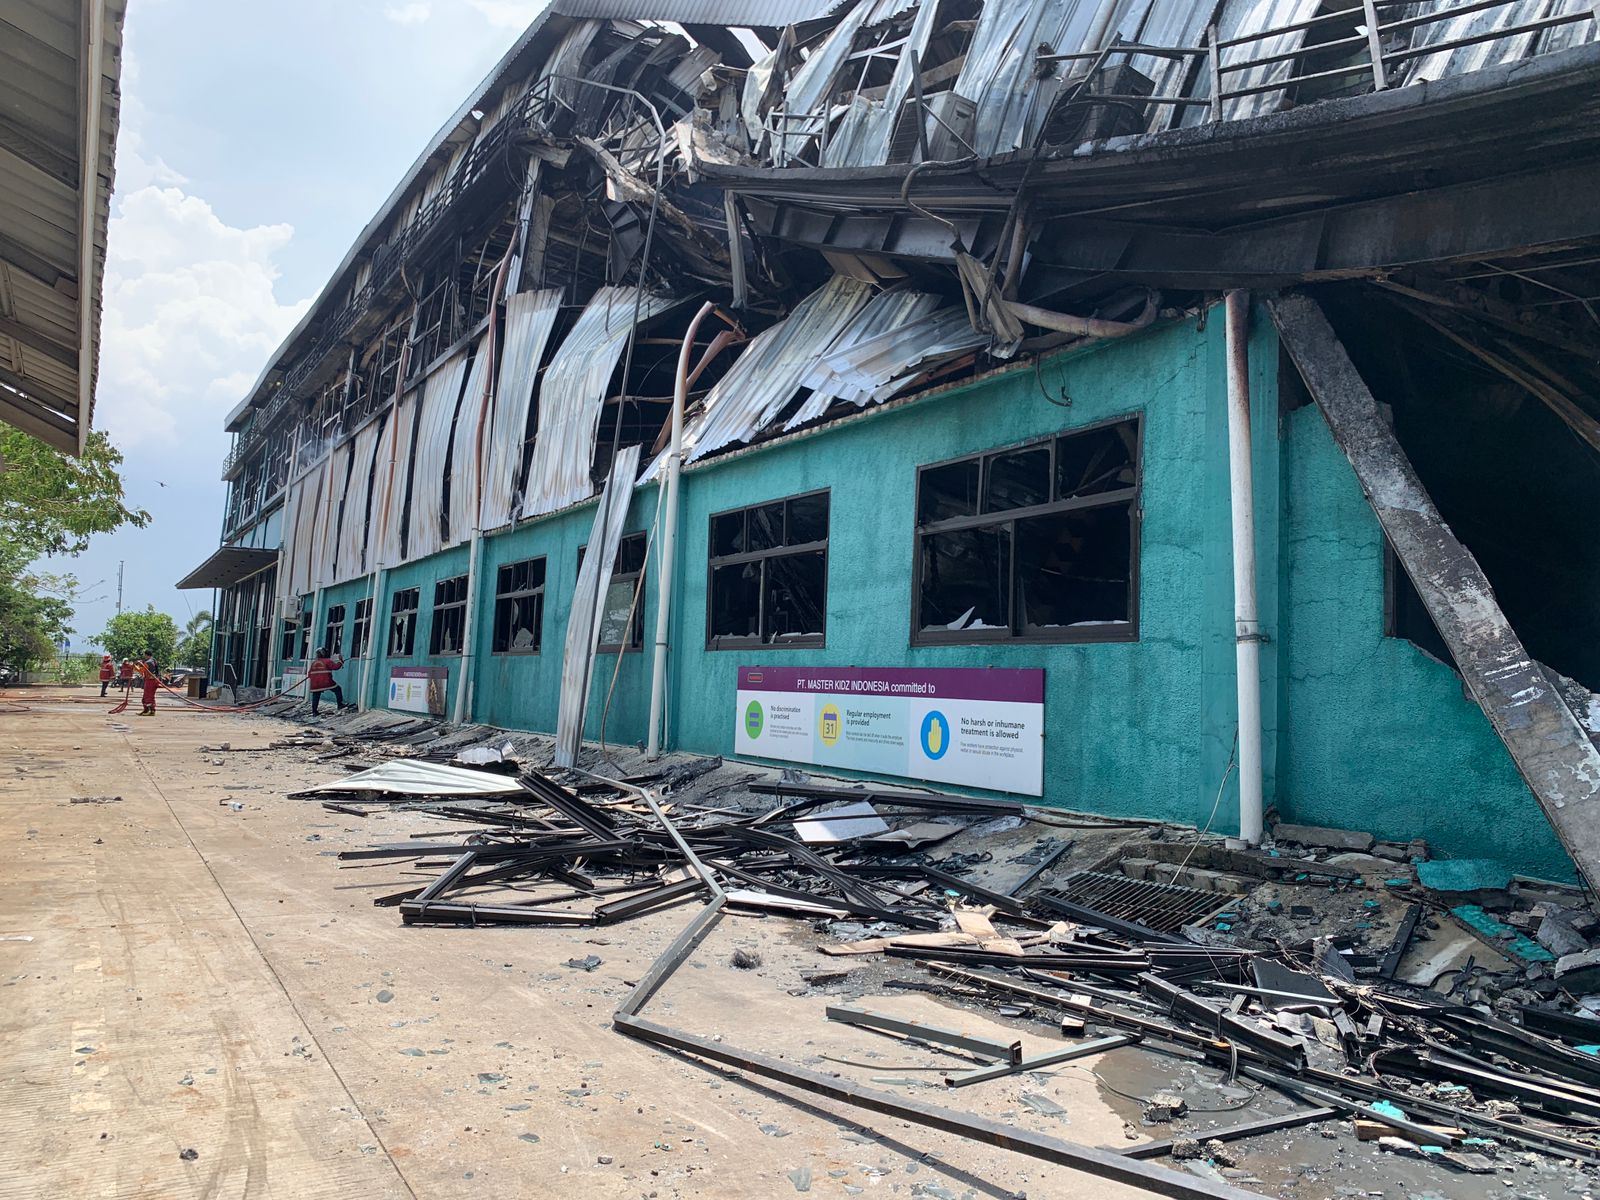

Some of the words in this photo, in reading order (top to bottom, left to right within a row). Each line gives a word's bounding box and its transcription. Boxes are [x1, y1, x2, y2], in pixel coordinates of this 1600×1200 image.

[797, 679, 807, 689] PT.
[808, 680, 833, 690] MASTER
[835, 680, 850, 690] KIDZ
[851, 680, 889, 692] INDONESIA
[891, 682, 926, 693] committed
[928, 683, 936, 694] to
[847, 710, 863, 718] Regular
[863, 711, 891, 720] employment
[826, 723, 835, 734] 31
[850, 719, 870, 727] provided
[961, 717, 969, 725] No
[970, 718, 986, 727] harsh
[995, 719, 1025, 730] inhumane
[961, 727, 988, 736] treatment
[990, 729, 995, 737] is
[995, 730, 1019, 739] allowed
